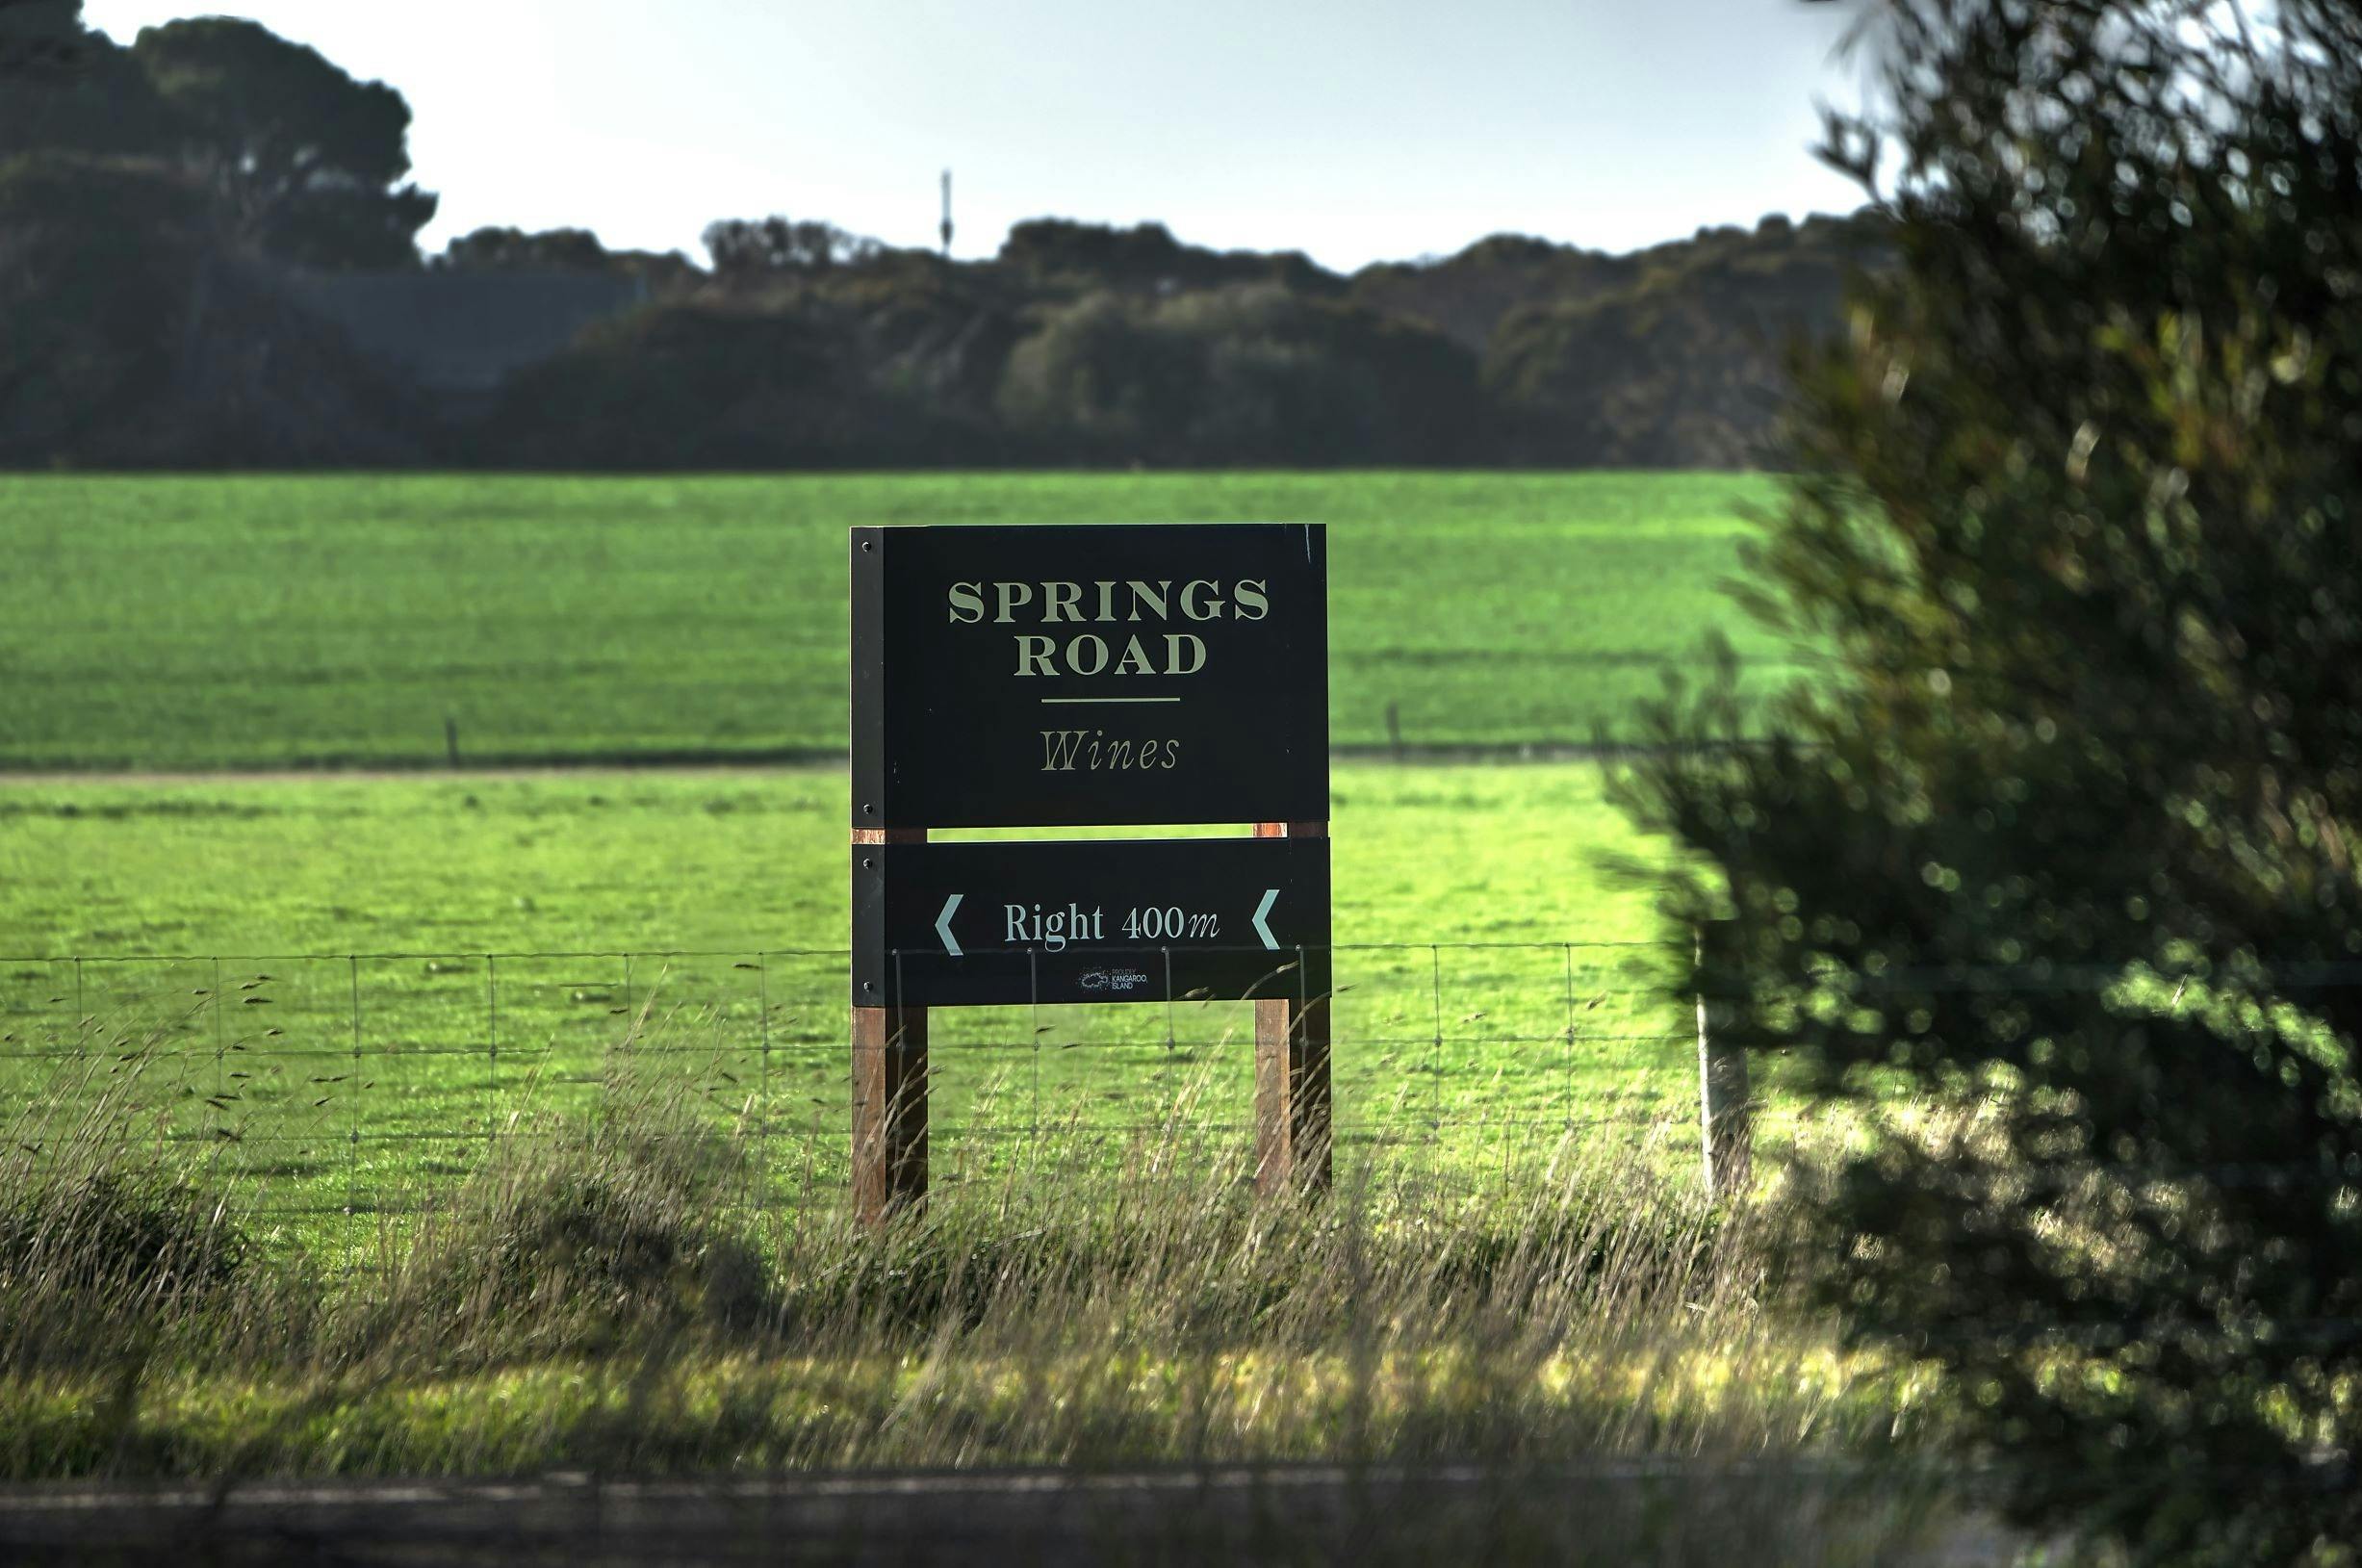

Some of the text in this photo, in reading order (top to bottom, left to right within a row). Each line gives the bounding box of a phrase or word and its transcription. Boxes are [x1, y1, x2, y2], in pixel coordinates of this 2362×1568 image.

[948, 578, 1269, 624] SPRINGS
[1013, 633, 1207, 677] ROAD
[1040, 730, 1180, 771] Wines
[1003, 902, 1220, 953] Right 400m
